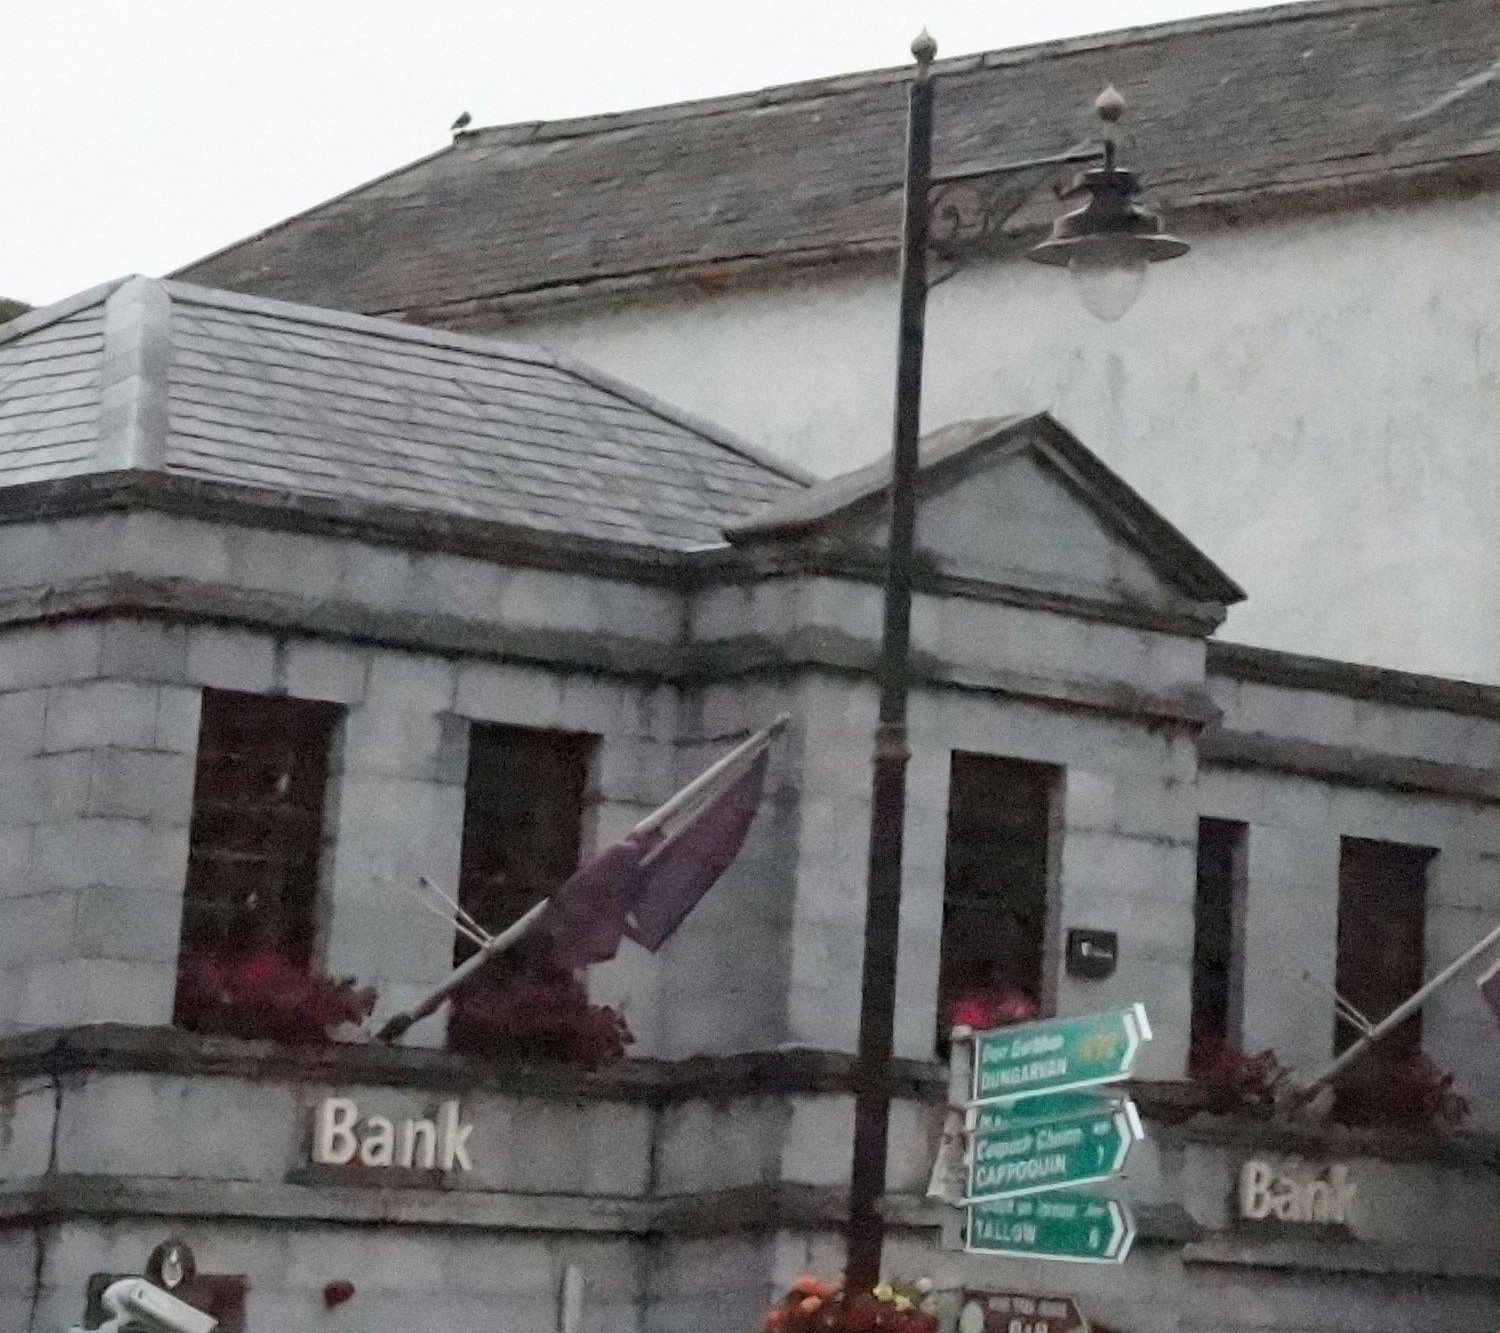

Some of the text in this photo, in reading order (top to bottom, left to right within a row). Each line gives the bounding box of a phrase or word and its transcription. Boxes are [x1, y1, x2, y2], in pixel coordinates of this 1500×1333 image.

[981, 1056, 1067, 1091] DUNGARVAN
[312, 1097, 474, 1171] Bank
[976, 1153, 1067, 1188] CAPPOQUIN
[1240, 1160, 1358, 1222] Bank
[975, 1219, 1037, 1244] TALLOW
